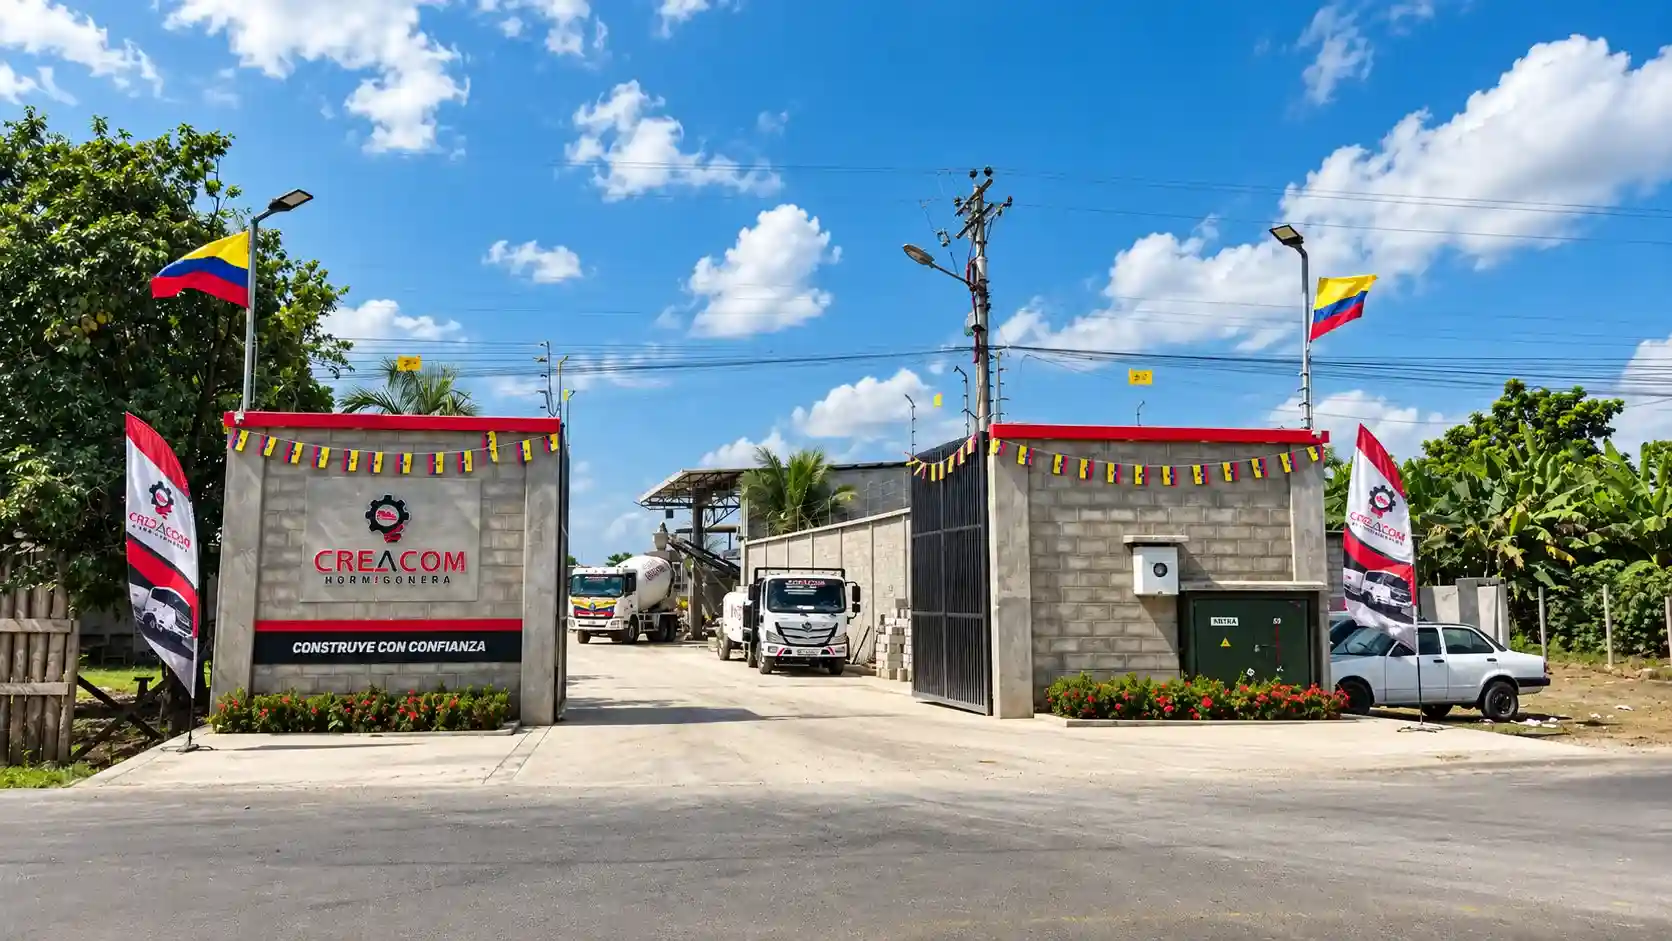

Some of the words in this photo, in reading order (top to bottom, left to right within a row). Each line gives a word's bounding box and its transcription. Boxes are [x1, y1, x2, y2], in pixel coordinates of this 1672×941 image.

[313, 549, 467, 573] CREACOM
[324, 575, 452, 585] HORMIGONERA
[292, 641, 376, 654] CONSTRUYE
[377, 641, 407, 653] CON
[408, 640, 487, 653] CONFIANZA
